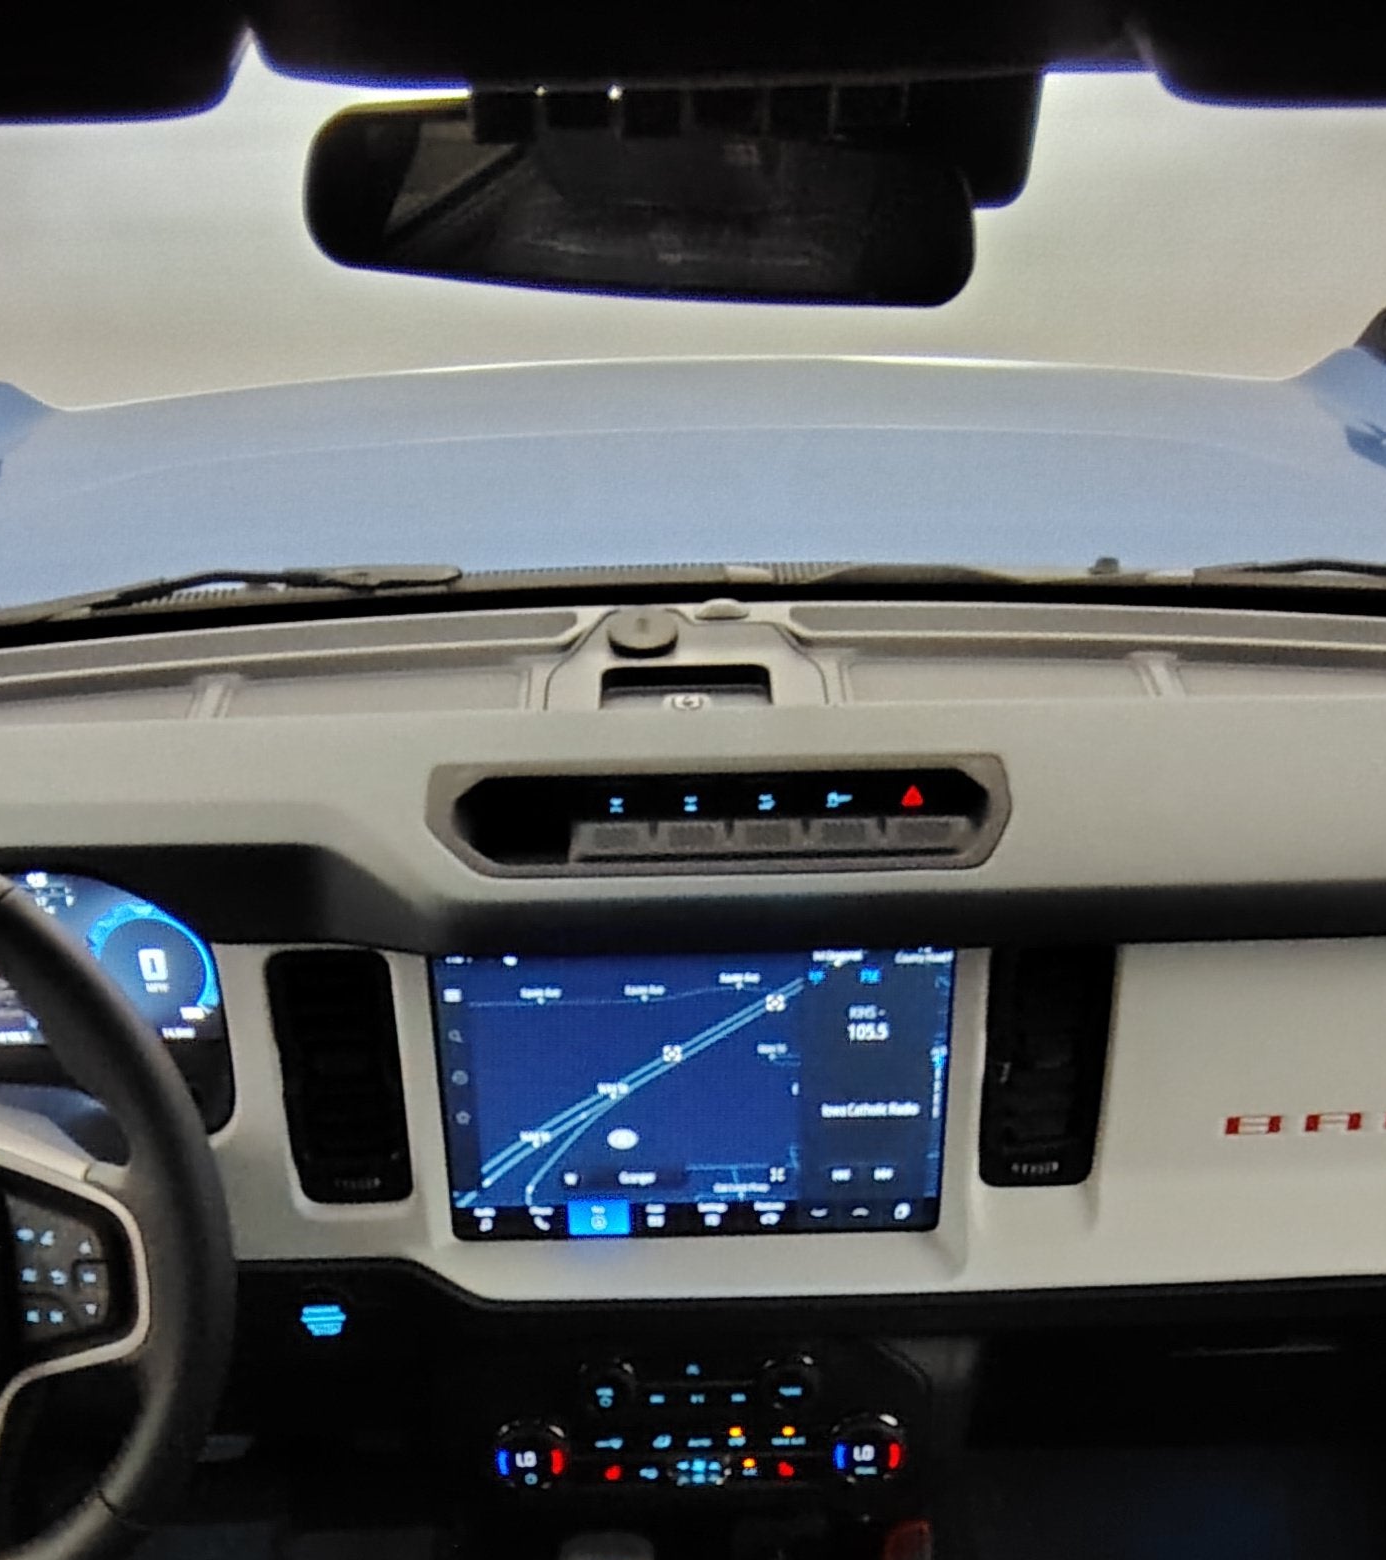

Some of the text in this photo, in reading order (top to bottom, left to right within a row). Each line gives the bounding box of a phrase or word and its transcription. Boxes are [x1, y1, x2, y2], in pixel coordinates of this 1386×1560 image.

[138, 948, 168, 981] 0
[847, 1022, 889, 1041] 105.5
[853, 1444, 875, 1462] LO
